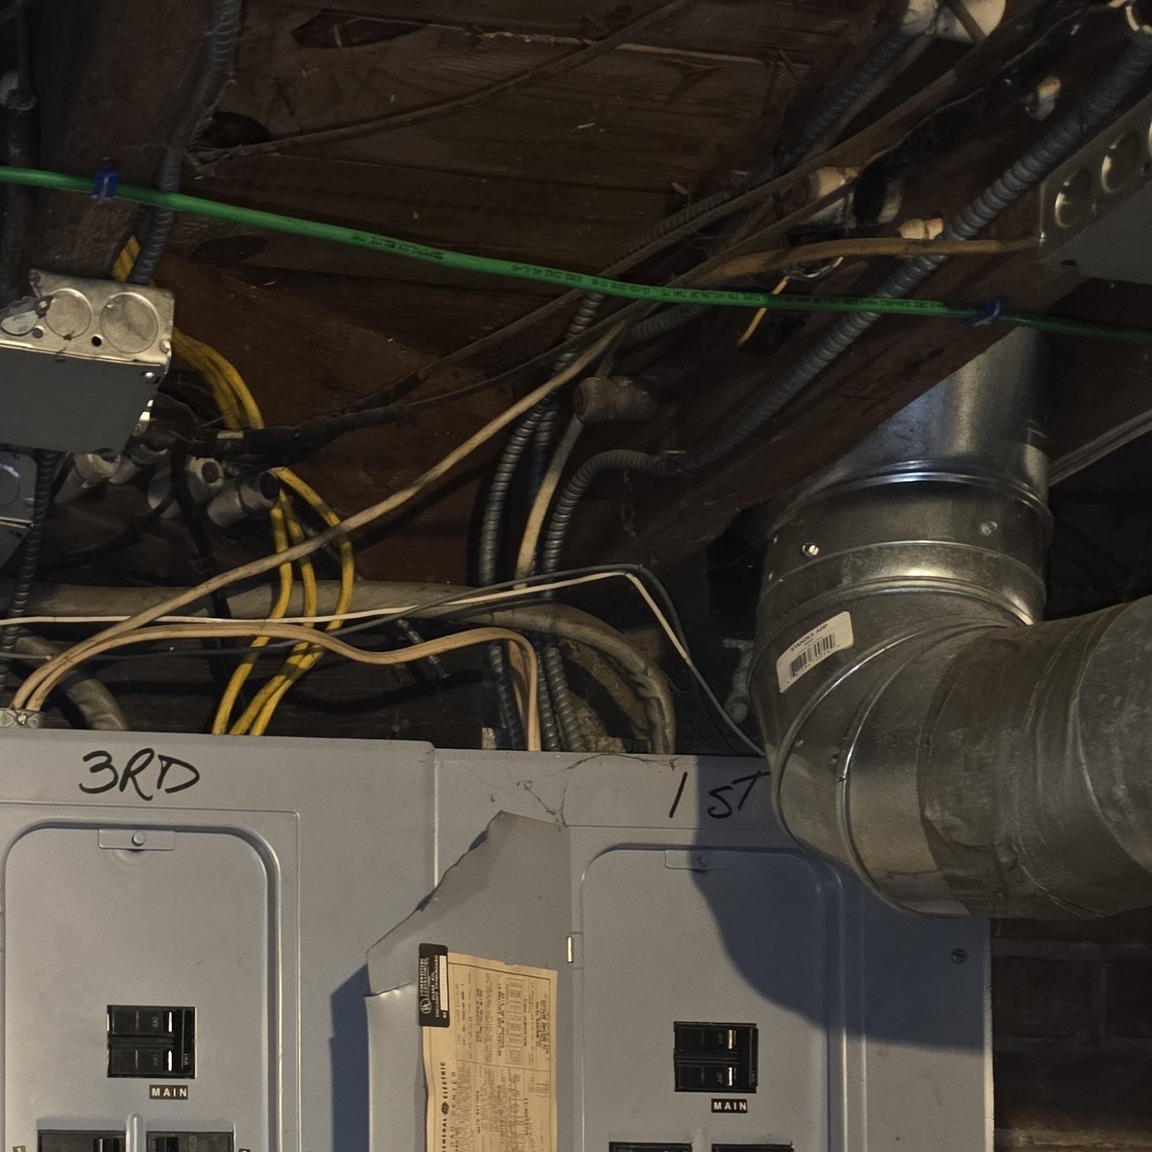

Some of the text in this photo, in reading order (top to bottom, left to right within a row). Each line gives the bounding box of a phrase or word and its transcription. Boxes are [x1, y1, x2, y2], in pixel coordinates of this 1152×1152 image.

[78, 747, 200, 801] 3RD
[151, 1087, 187, 1098] MAIN
[440, 1062, 448, 1099] ELECTRIC
[713, 1101, 748, 1111] MAIN
